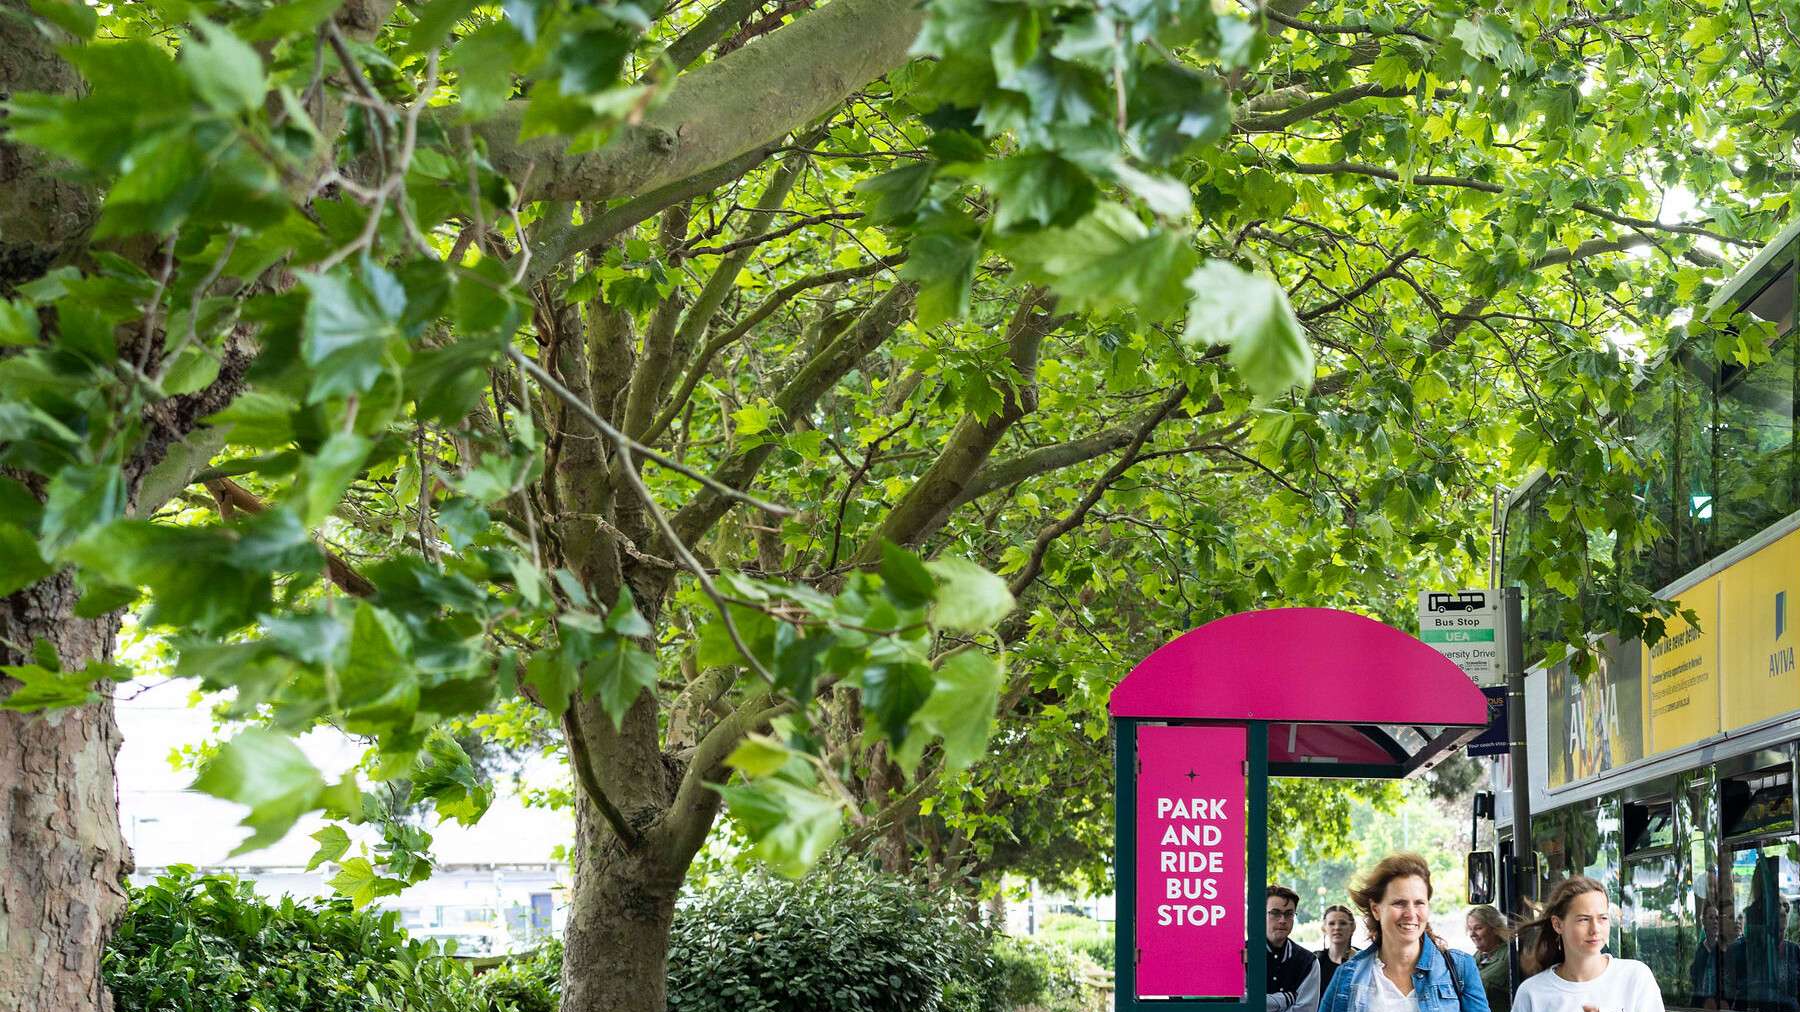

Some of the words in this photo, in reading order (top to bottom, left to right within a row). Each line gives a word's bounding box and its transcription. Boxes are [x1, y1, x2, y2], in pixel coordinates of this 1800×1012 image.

[1435, 618, 1454, 627] Bus
[1457, 618, 1480, 628] Stop
[1446, 631, 1470, 642] UEA
[1473, 649, 1496, 658] Drive
[1769, 646, 1795, 678] AVIVA
[1569, 683, 1620, 755] AVVA
[1157, 797, 1228, 820] PARK
[1160, 824, 1222, 846] AND
[1160, 851, 1224, 873] RIDE
[1166, 878, 1218, 900] BUS
[1157, 904, 1226, 926] STOP
